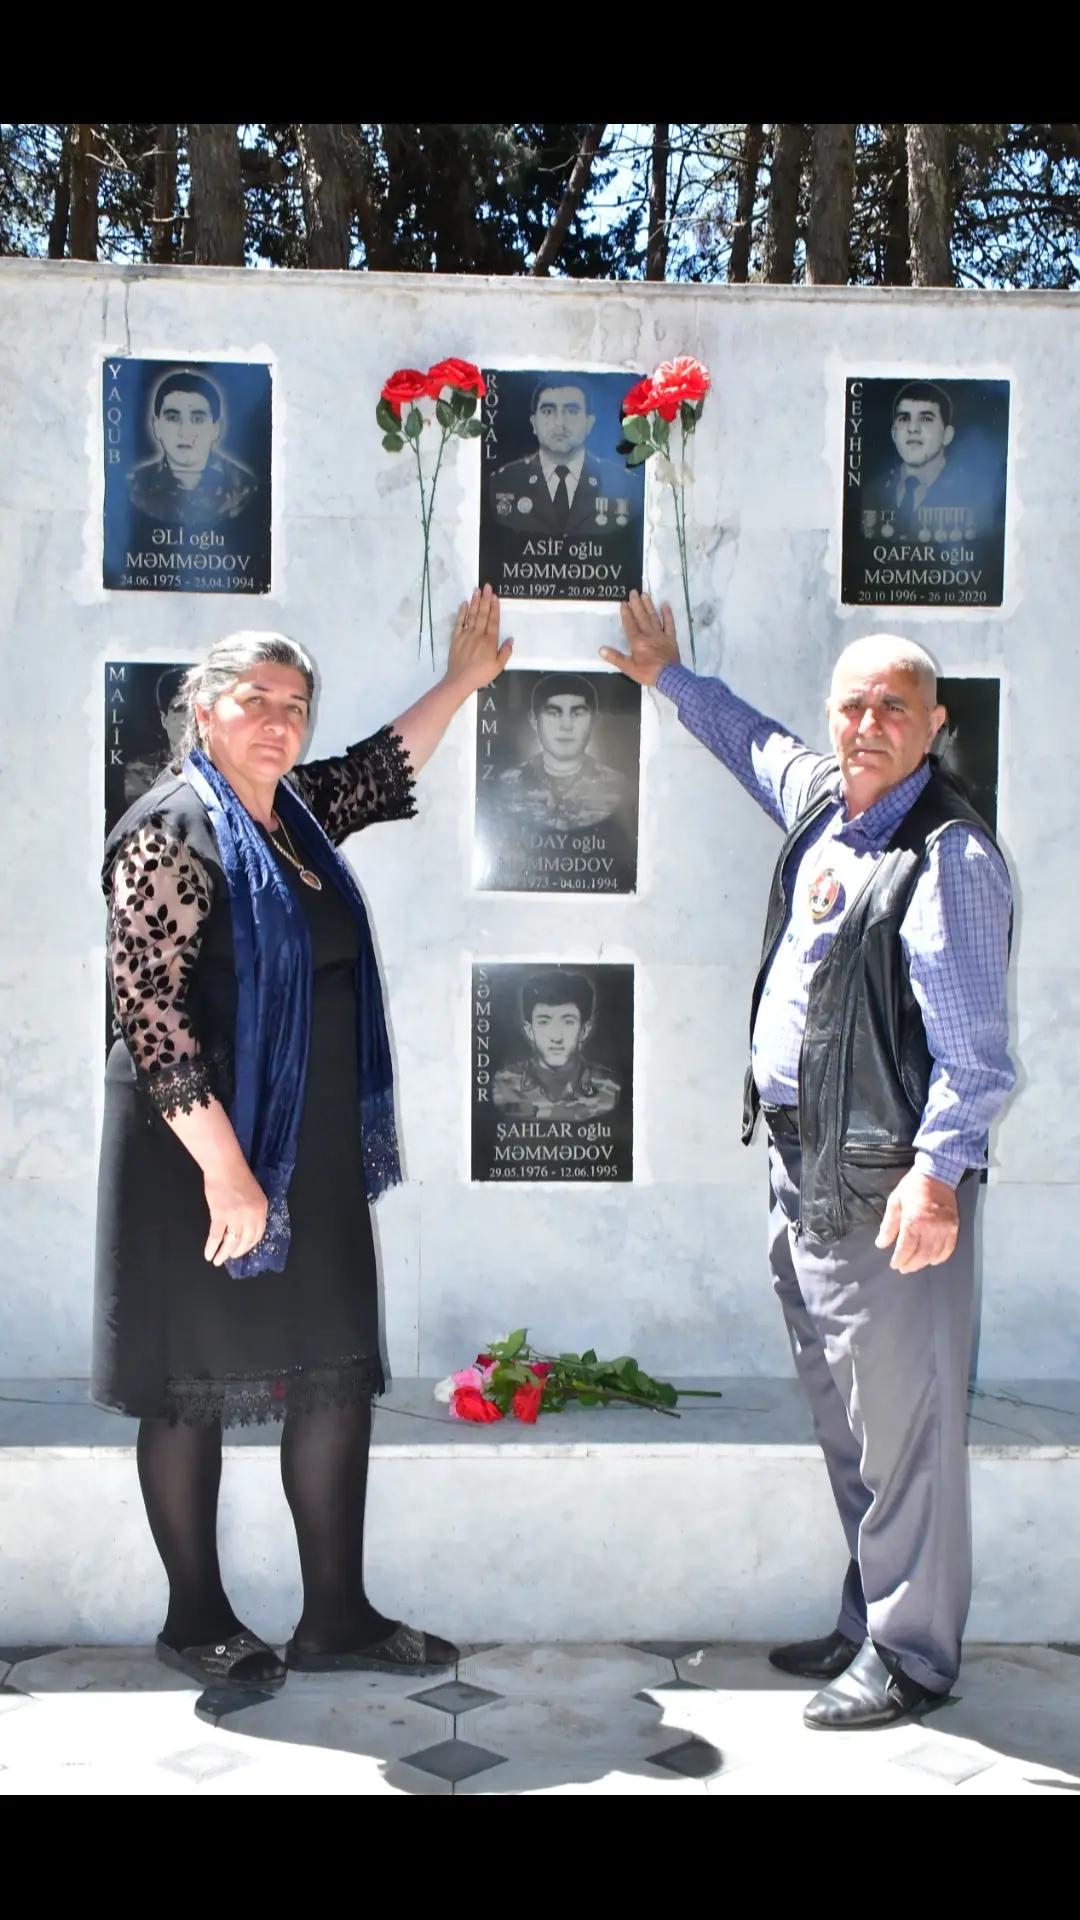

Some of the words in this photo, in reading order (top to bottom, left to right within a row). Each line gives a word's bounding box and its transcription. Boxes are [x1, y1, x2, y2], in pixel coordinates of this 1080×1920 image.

[108, 364, 122, 464] YAQUB
[484, 373, 499, 460] RÖYAL
[848, 382, 863, 487] CEYHUN
[151, 526, 184, 545] ƏLİ
[189, 530, 225, 550] oğlu
[522, 537, 564, 556] ASİF
[568, 541, 603, 560] oğlu
[873, 545, 936, 563] QAFAR
[940, 546, 974, 565] oğlu
[126, 551, 250, 571] MƏMMƏDOV
[503, 562, 622, 580] MƏMMƏDOV
[864, 569, 982, 585] MƏMMƏDOV
[109, 666, 127, 765] MALİK
[572, 834, 606, 854] oğlu
[499, 856, 614, 873] MMƏDOV
[476, 967, 491, 1102] SƏMƏNDƏR
[496, 1122, 573, 1142] ŞAHLAR
[577, 1123, 611, 1141] oğlu
[494, 1145, 614, 1161] MƏMMƏDOV
[489, 1166, 548, 1178] 29.05.1976
[561, 1165, 618, 1177] 12.06.1995
